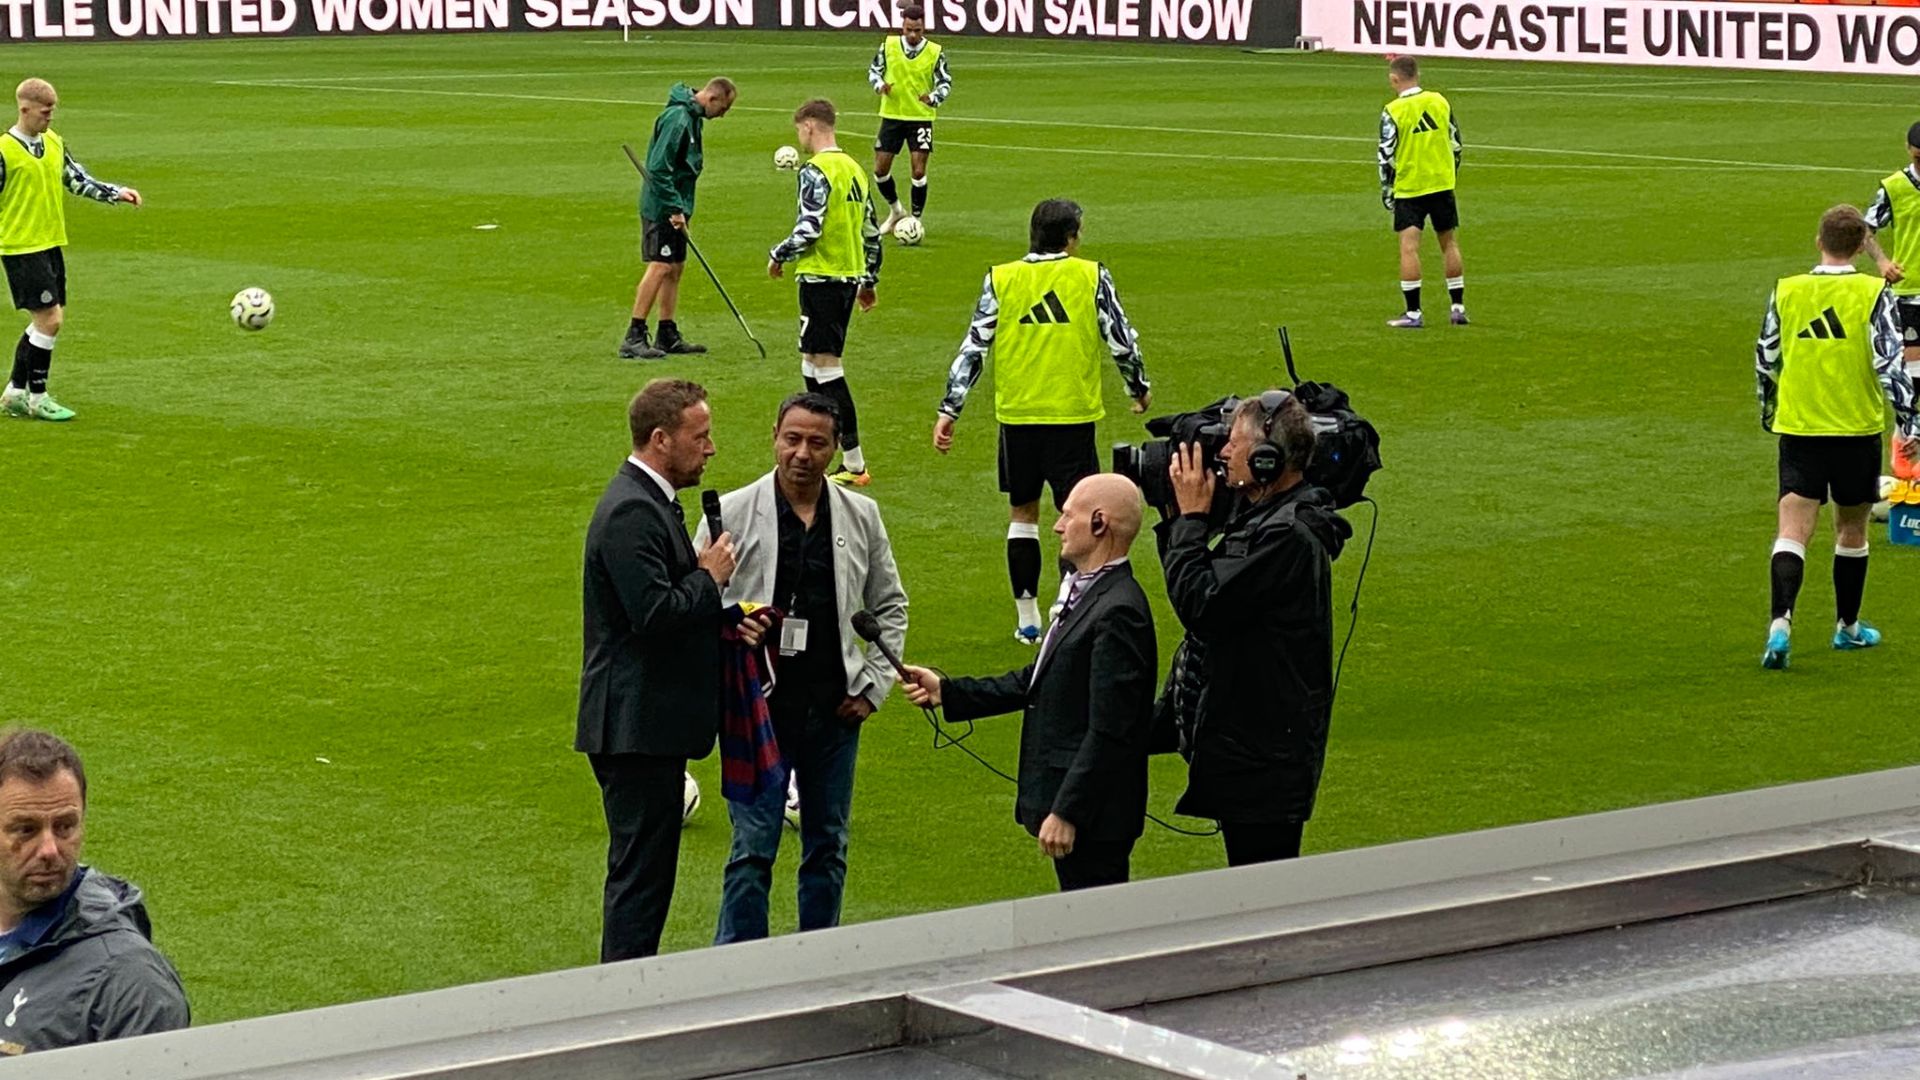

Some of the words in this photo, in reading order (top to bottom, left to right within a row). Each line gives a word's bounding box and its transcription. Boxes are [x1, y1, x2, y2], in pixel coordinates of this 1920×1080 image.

[0, 0, 95, 38] TLE
[108, 0, 297, 37] UNITED
[311, 0, 509, 32] WOMEN
[524, 0, 754, 28] SEASON
[976, 0, 1034, 33] ON
[1044, 0, 1141, 37] SALE
[1150, 0, 1252, 41] NOW
[1353, 0, 1628, 55] NEWCASTLE
[1643, 8, 1821, 61] UNITED
[1837, 14, 1920, 67] WO
[917, 127, 932, 143] 23
